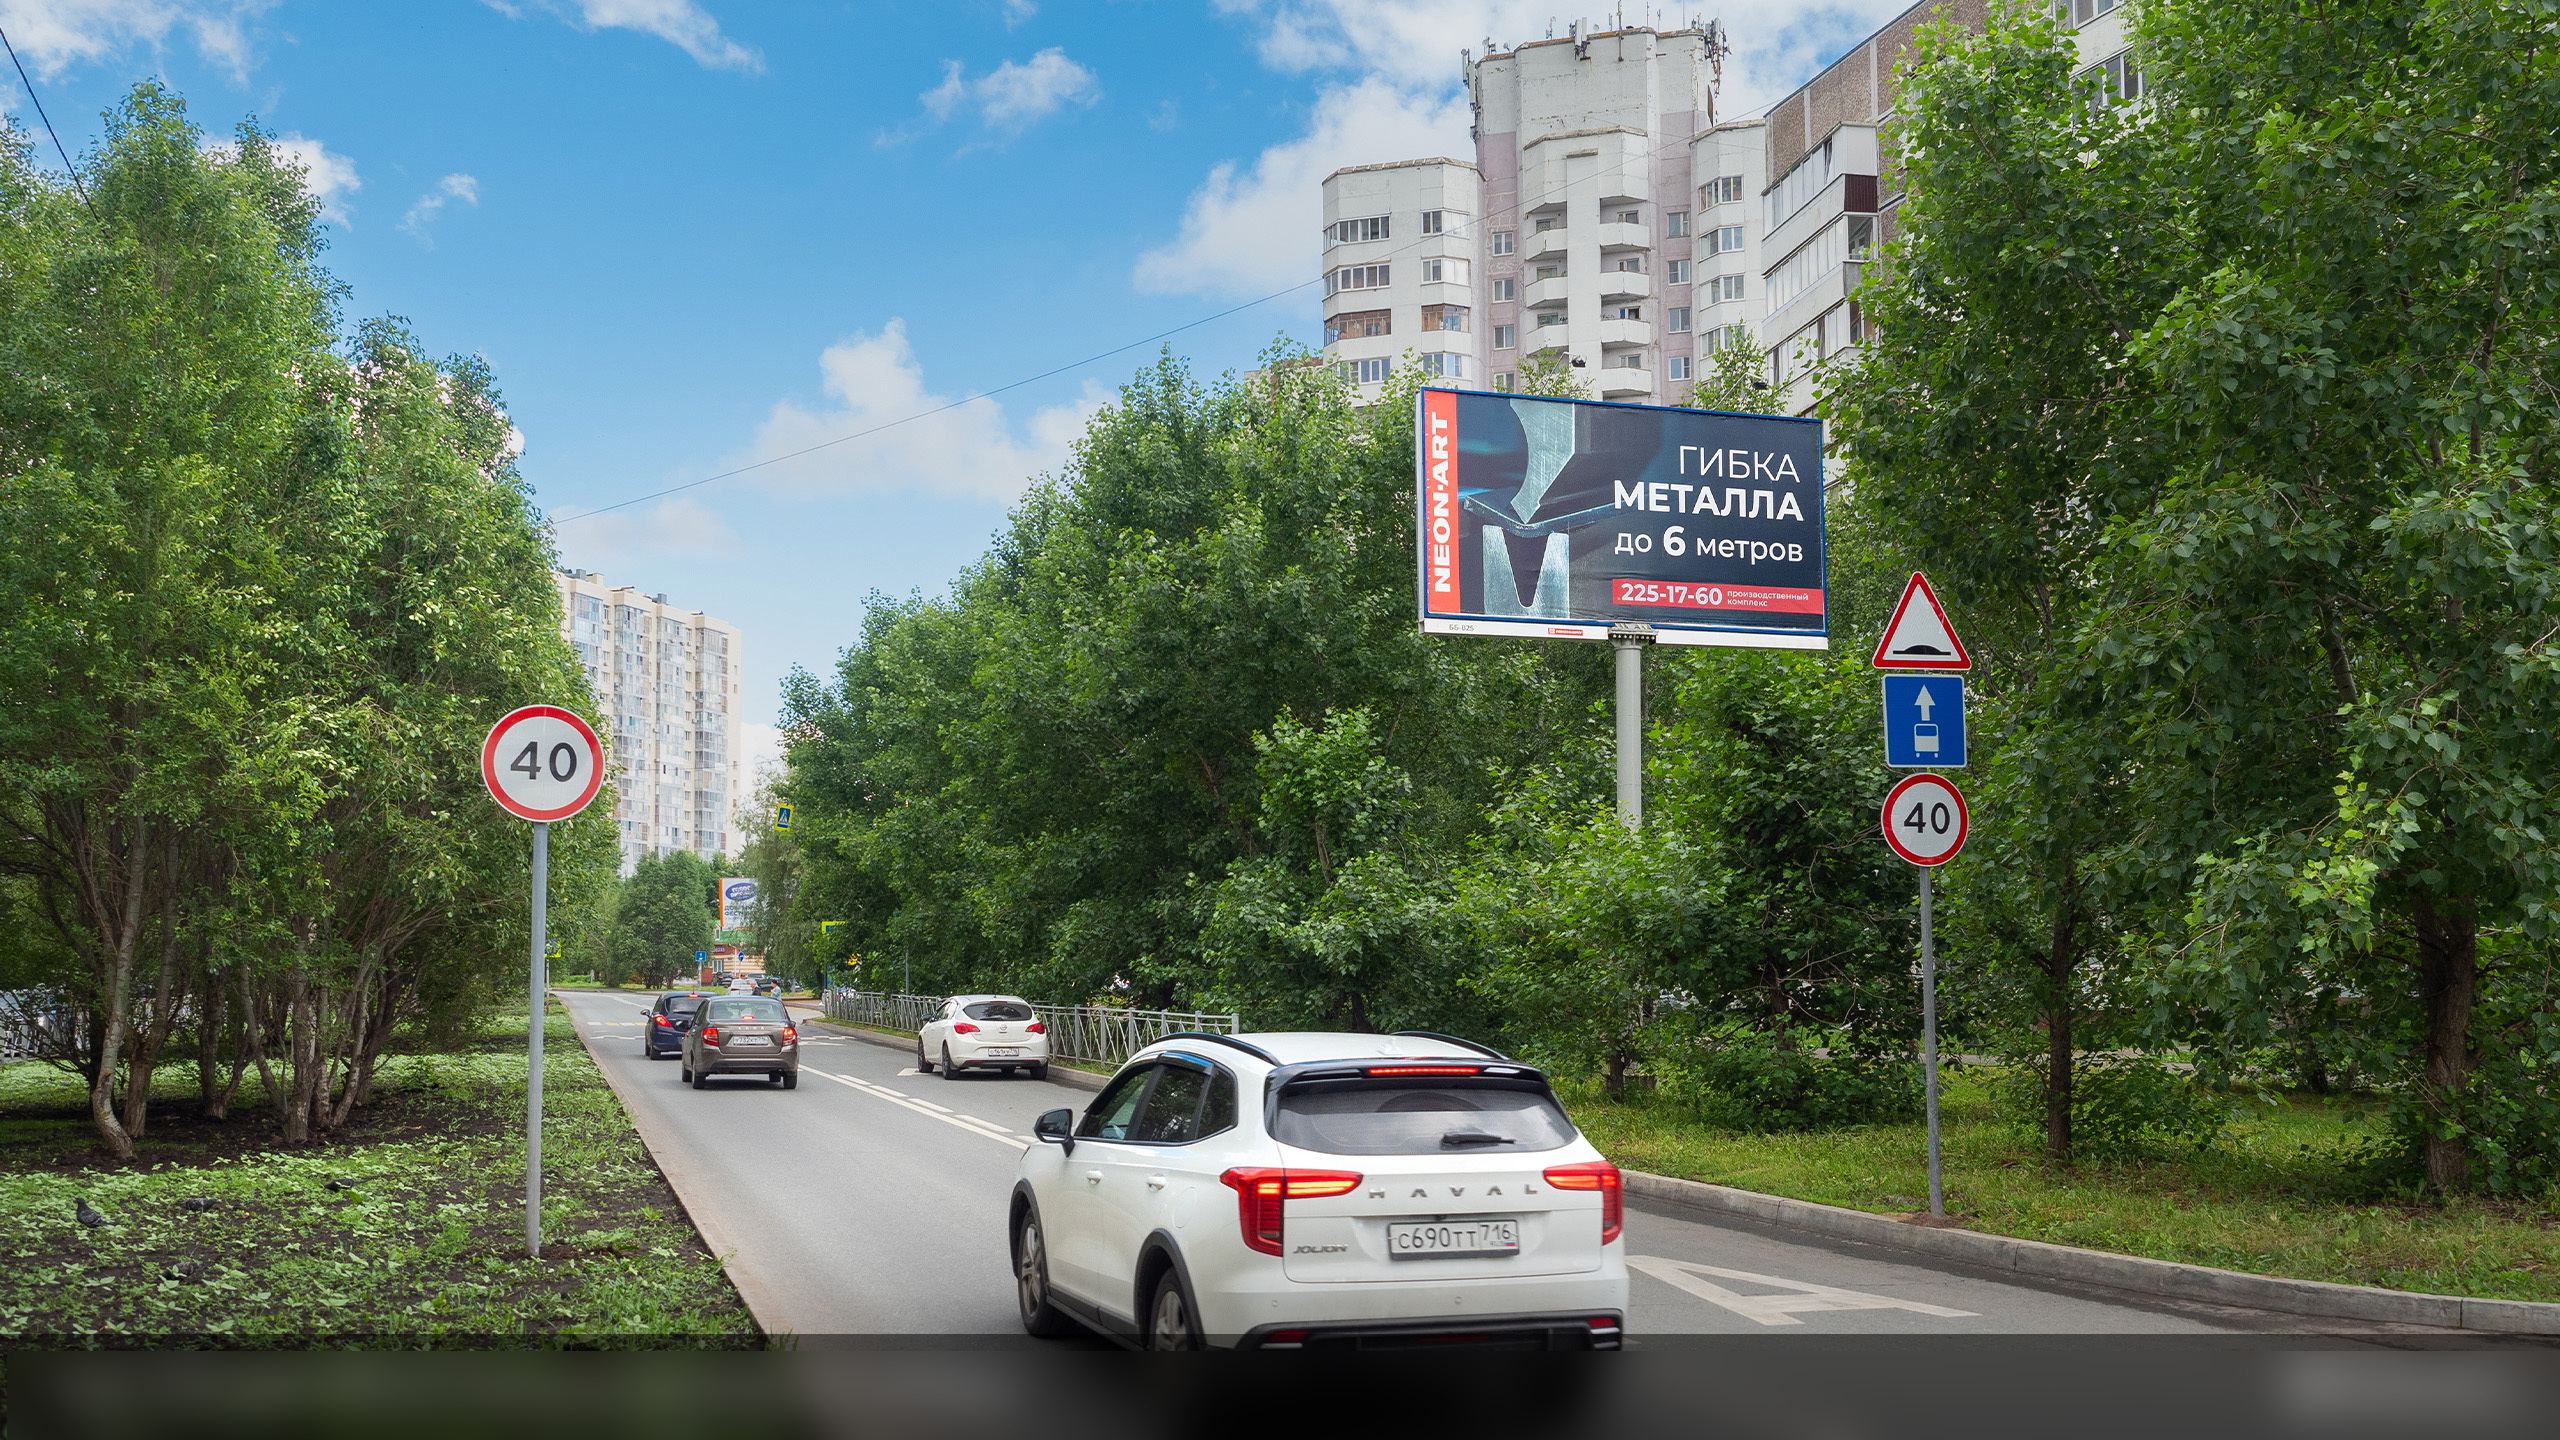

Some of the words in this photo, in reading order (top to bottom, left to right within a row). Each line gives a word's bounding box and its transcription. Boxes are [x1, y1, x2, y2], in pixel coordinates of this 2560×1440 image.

[1679, 445, 1801, 483] ГИБКА
[1614, 479, 1804, 521] МЕТАЛЛА
[1614, 532, 1653, 556] до
[1663, 525, 1686, 556] 6
[1696, 537, 1804, 565] метров
[1621, 583, 1723, 605] 225-17-60
[1727, 590, 1809, 601] производственный
[1727, 599, 1768, 607] комплекс
[510, 741, 577, 782] 40
[1904, 802, 1951, 835] 40
[1369, 1184, 1537, 1199] HAVAL
[1293, 1244, 1347, 1255] JOLION
